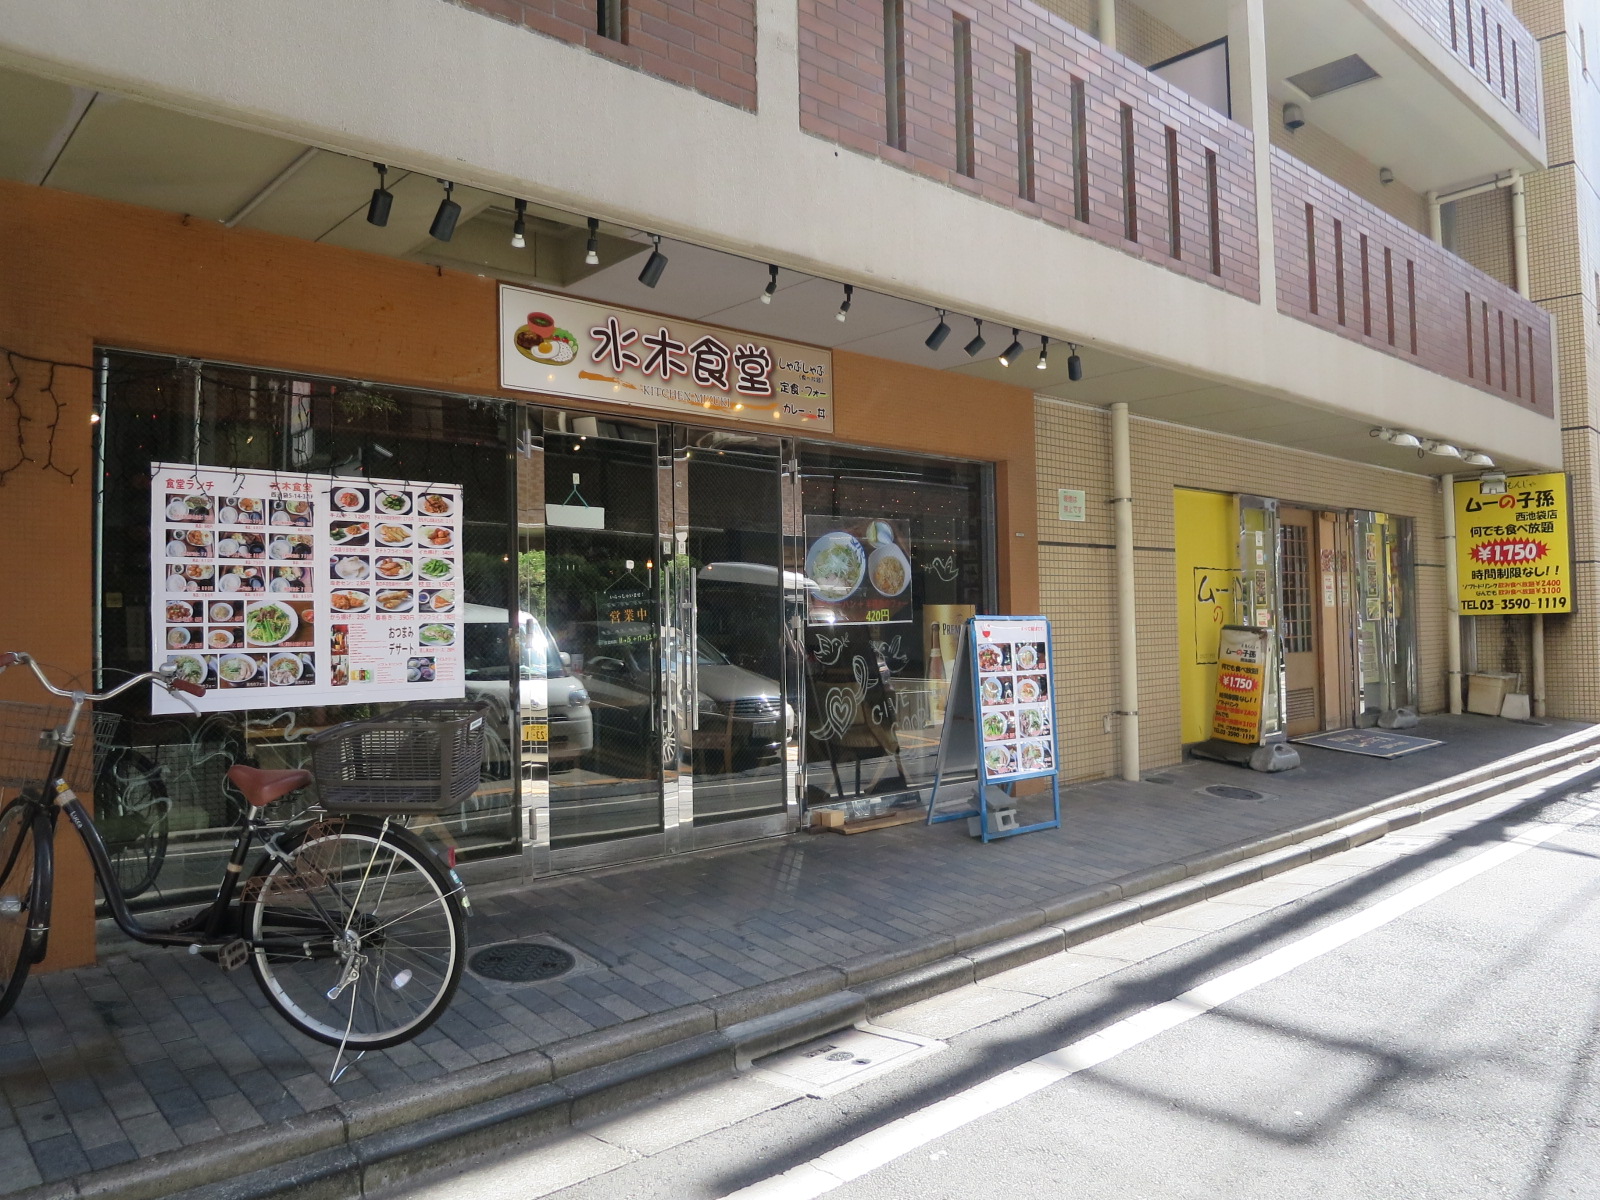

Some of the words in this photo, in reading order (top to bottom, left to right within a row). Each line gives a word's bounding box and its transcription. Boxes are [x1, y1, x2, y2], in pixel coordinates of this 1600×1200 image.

[590, 317, 771, 395] 水木食堂
[643, 385, 691, 401] KITCHEN
[165, 478, 214, 491] 食堂ランチ
[1465, 490, 1555, 512] ムーの子孫
[1515, 510, 1558, 521] 西池袋店
[1470, 521, 1555, 538] 何でも食べ放題
[609, 607, 647, 624] 営業中
[866, 609, 890, 622] 420円
[388, 626, 414, 639] おつまみ
